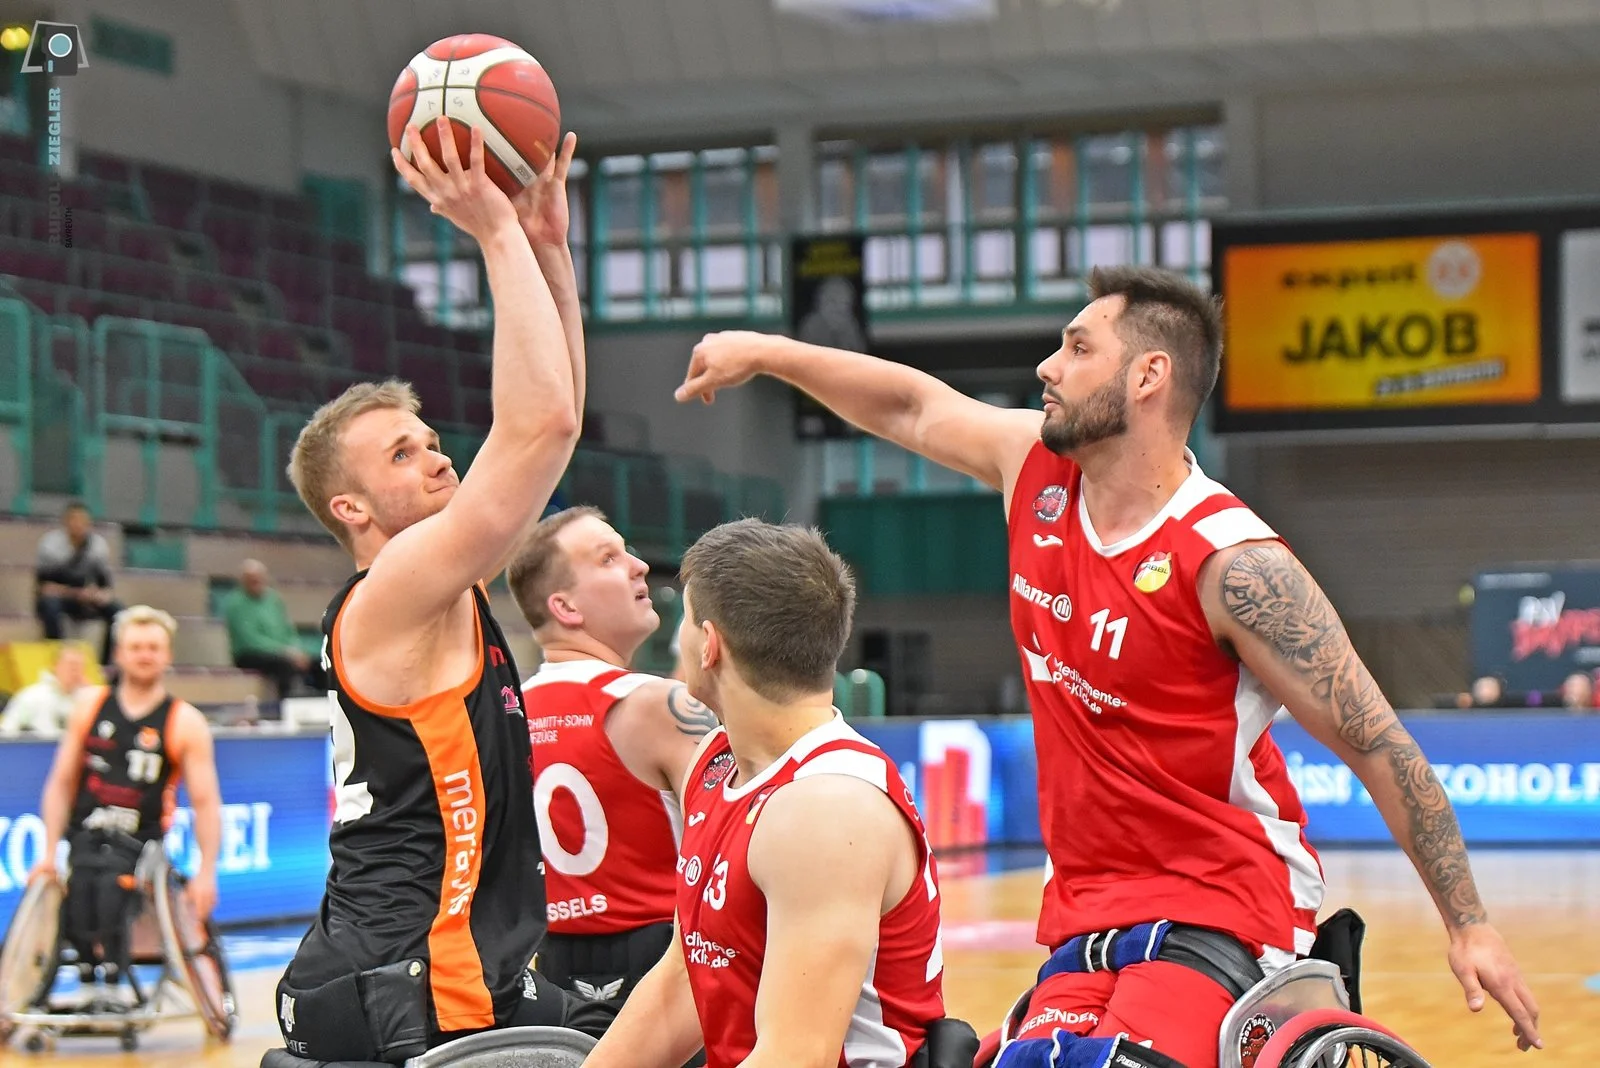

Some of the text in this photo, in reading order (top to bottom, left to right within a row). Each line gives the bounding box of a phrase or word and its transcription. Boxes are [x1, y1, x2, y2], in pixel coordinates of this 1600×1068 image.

[1281, 312, 1479, 363] JAKOB
[1012, 573, 1053, 609] Allianz
[1090, 608, 1129, 661] 11
[443, 769, 478, 916] meravis
[547, 894, 608, 923] SSELS
